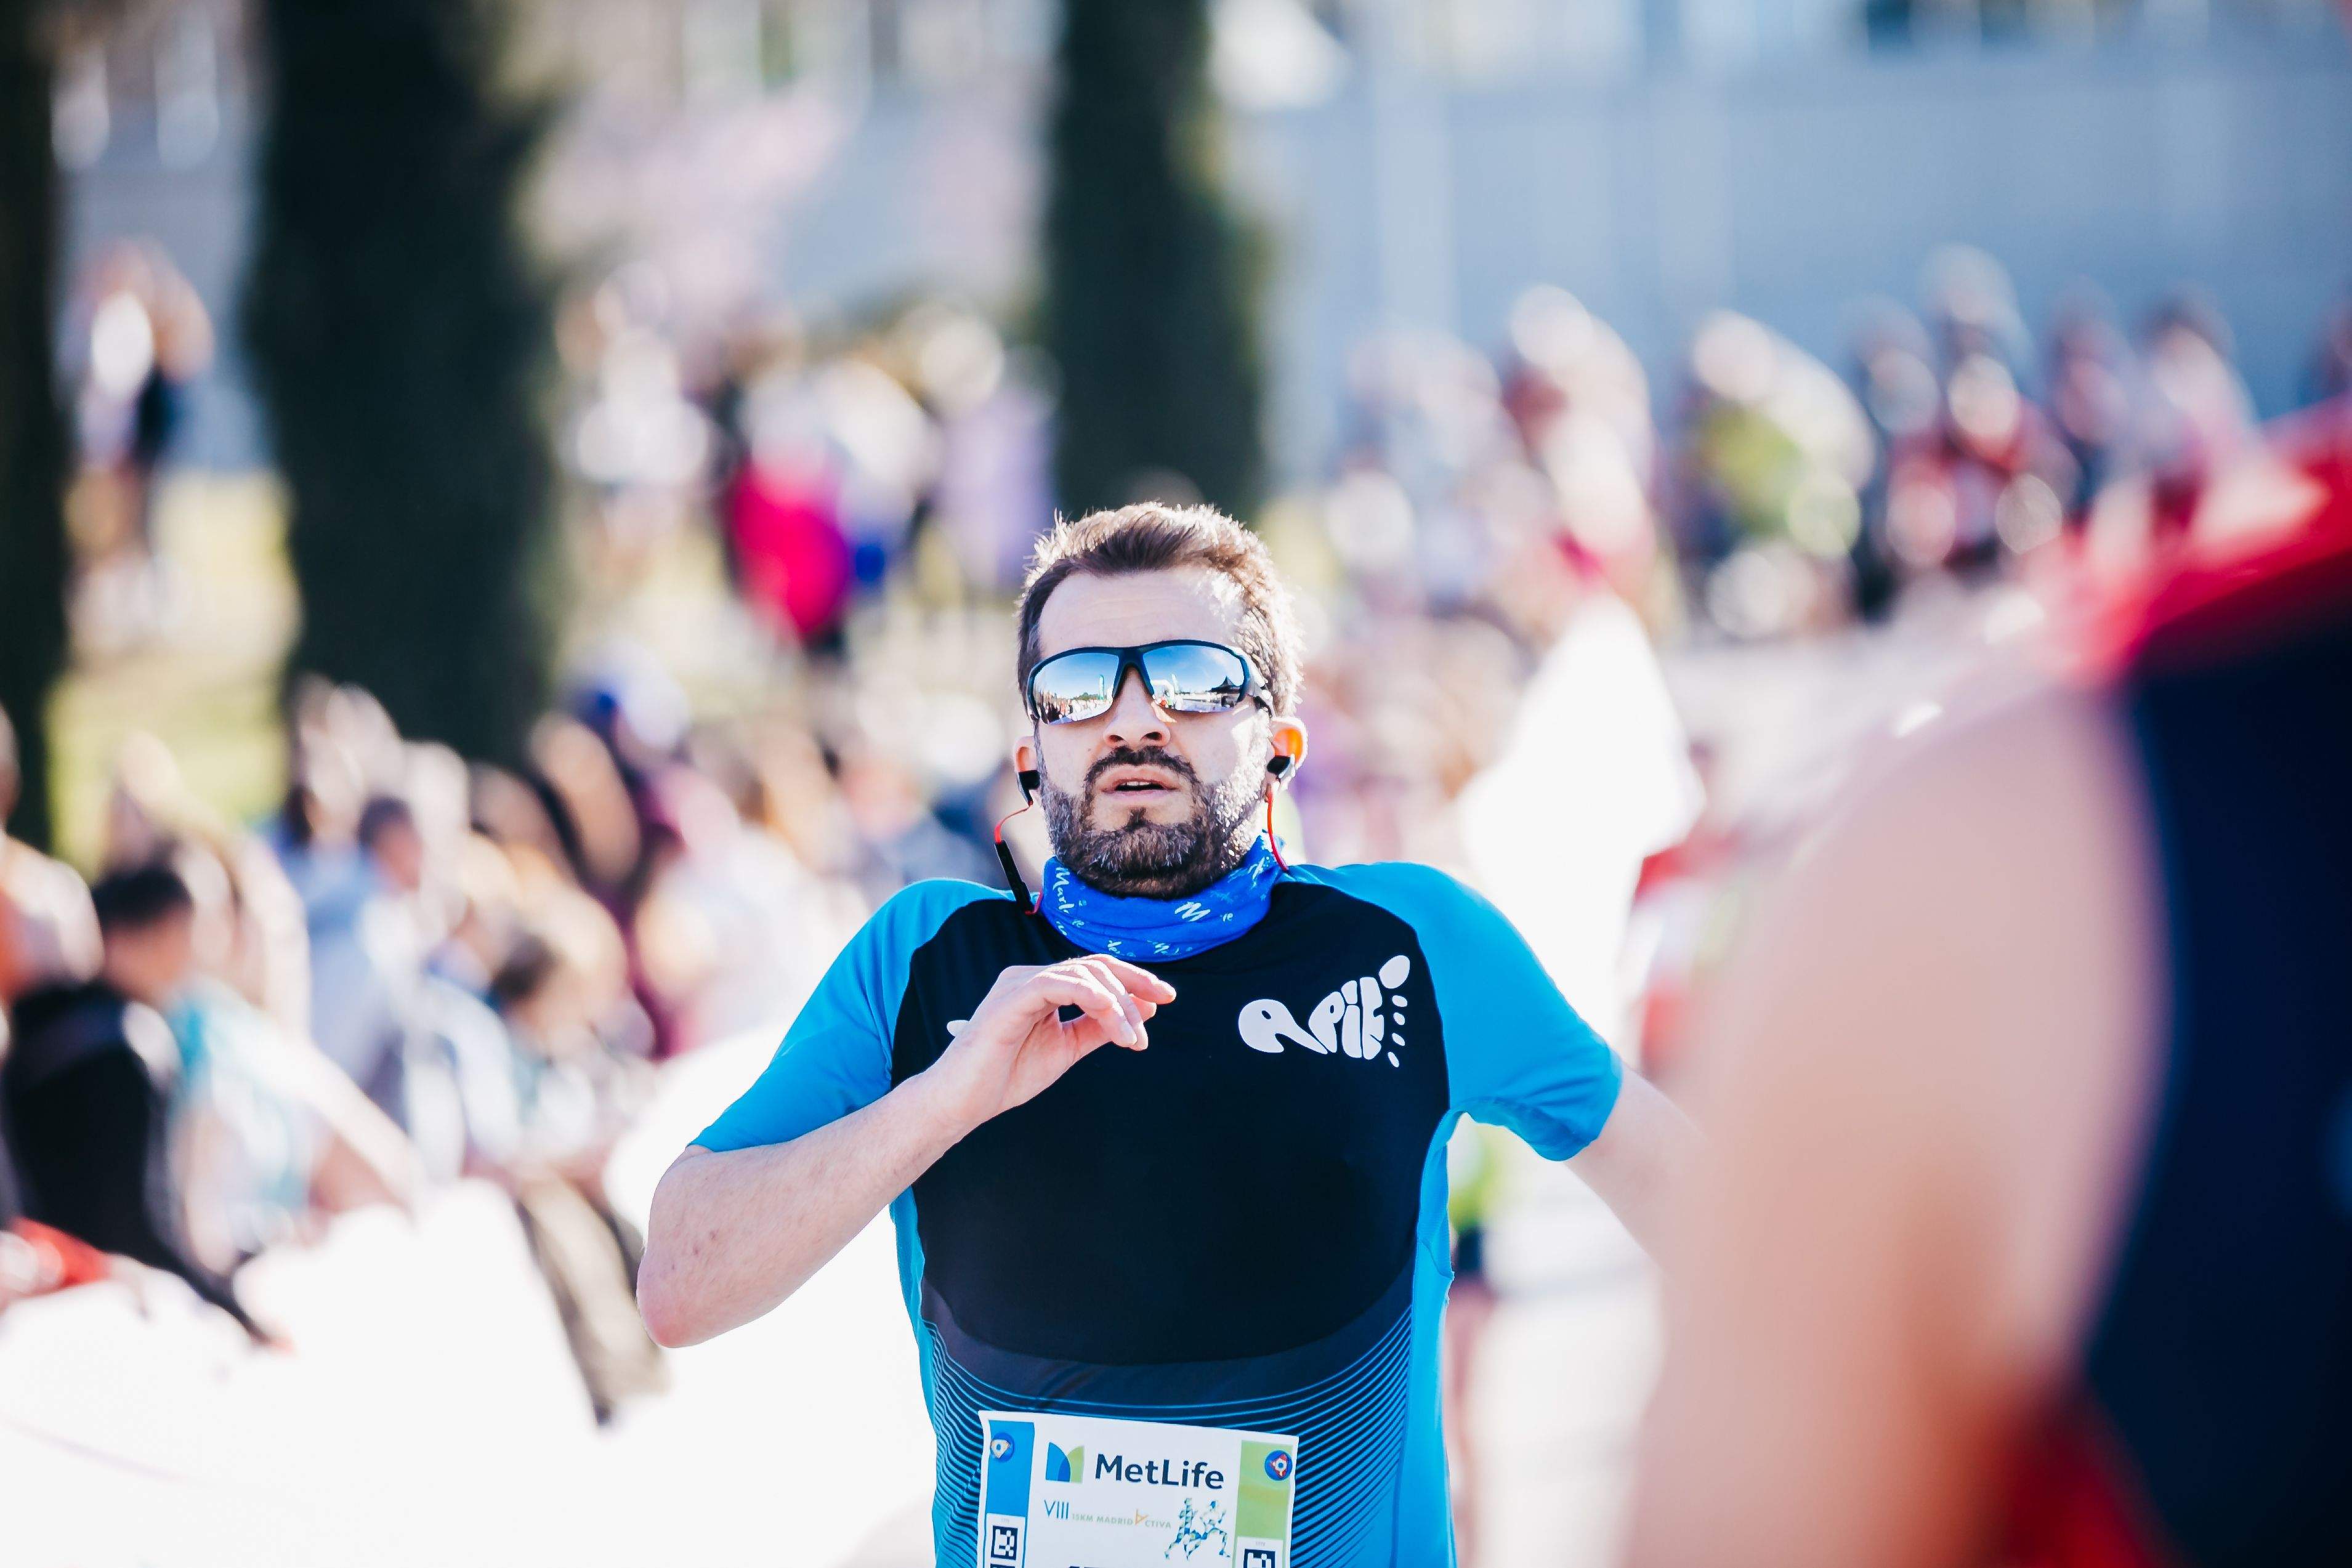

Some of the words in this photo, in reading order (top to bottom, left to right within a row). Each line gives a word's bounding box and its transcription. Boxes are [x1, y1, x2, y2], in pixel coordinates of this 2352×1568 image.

[1095, 1453, 1224, 1490] MetLife
[1044, 1499, 1069, 1520] VIII
[1096, 1516, 1133, 1526] MADRID
